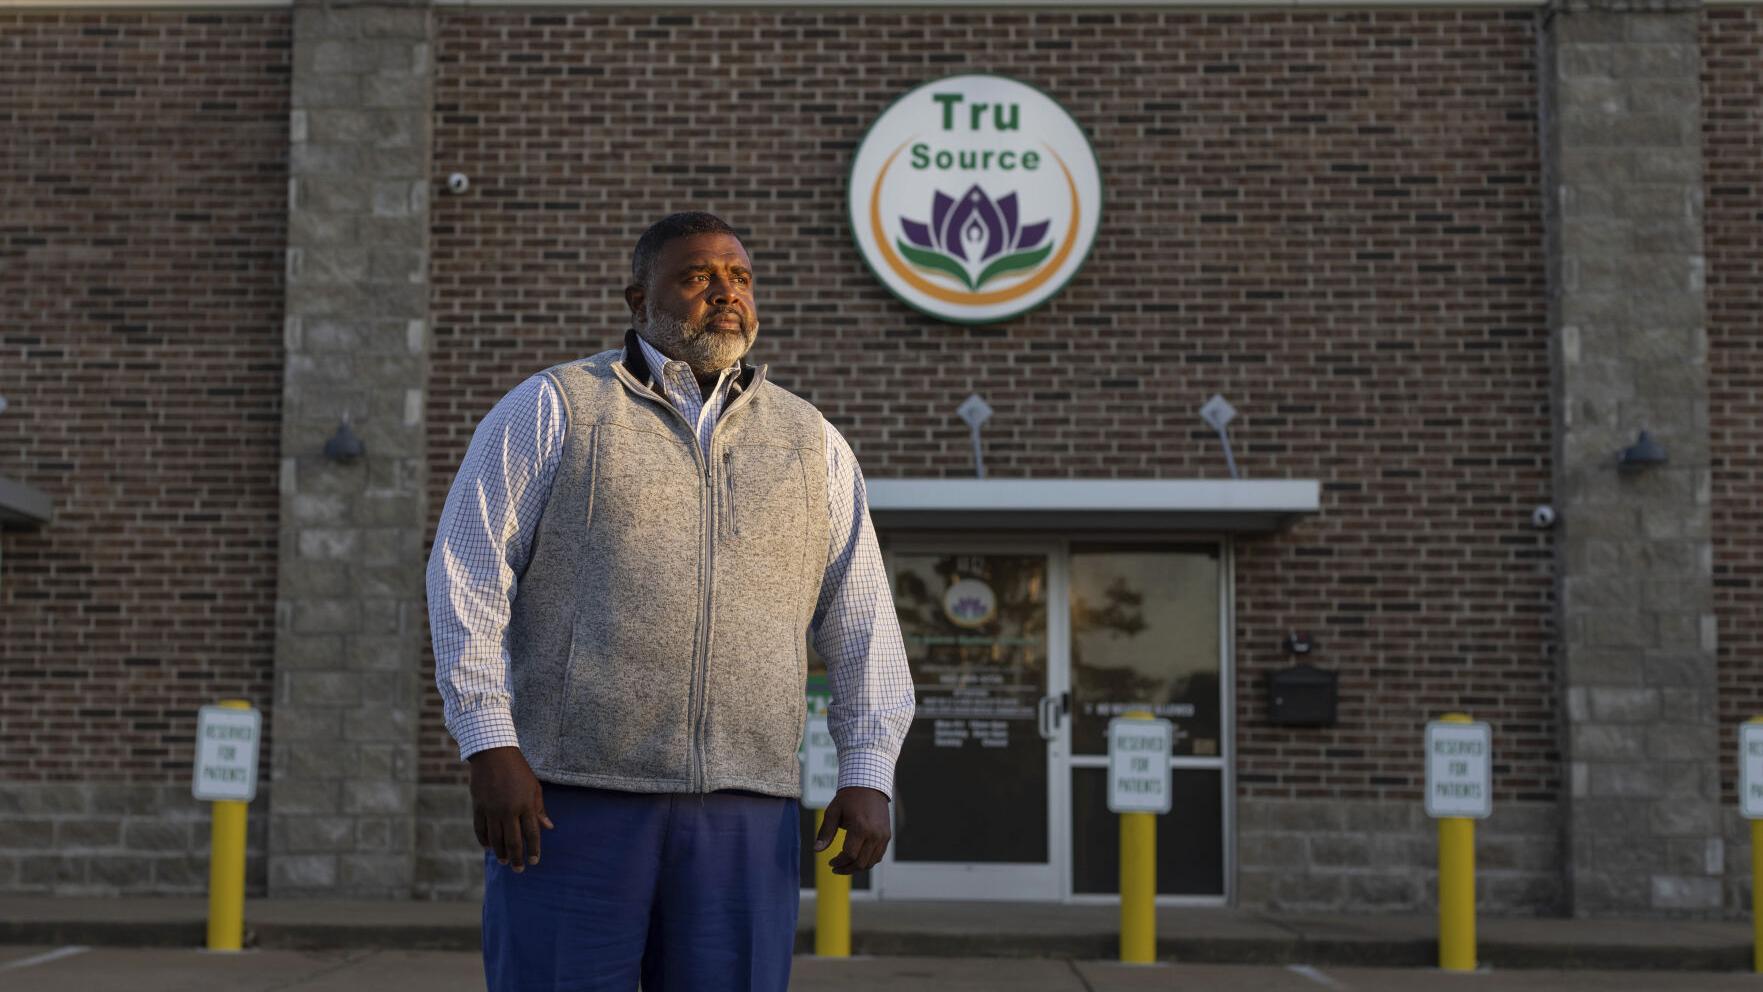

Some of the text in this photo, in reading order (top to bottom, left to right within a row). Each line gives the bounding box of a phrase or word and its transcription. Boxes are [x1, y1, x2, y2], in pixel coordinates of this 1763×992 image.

[933, 93, 1020, 131] Tru
[911, 143, 1042, 170] Source
[206, 724, 255, 741] RESERVED
[1117, 735, 1163, 752] RESERVED
[1434, 739, 1482, 757] RESERVED
[218, 745, 237, 762] FOR
[1130, 757, 1149, 773] FOR
[1449, 761, 1468, 777] FOR
[204, 766, 248, 783] PATIENTS
[1118, 778, 1162, 795] PATIENTS
[1436, 781, 1481, 799] PATIENTS
